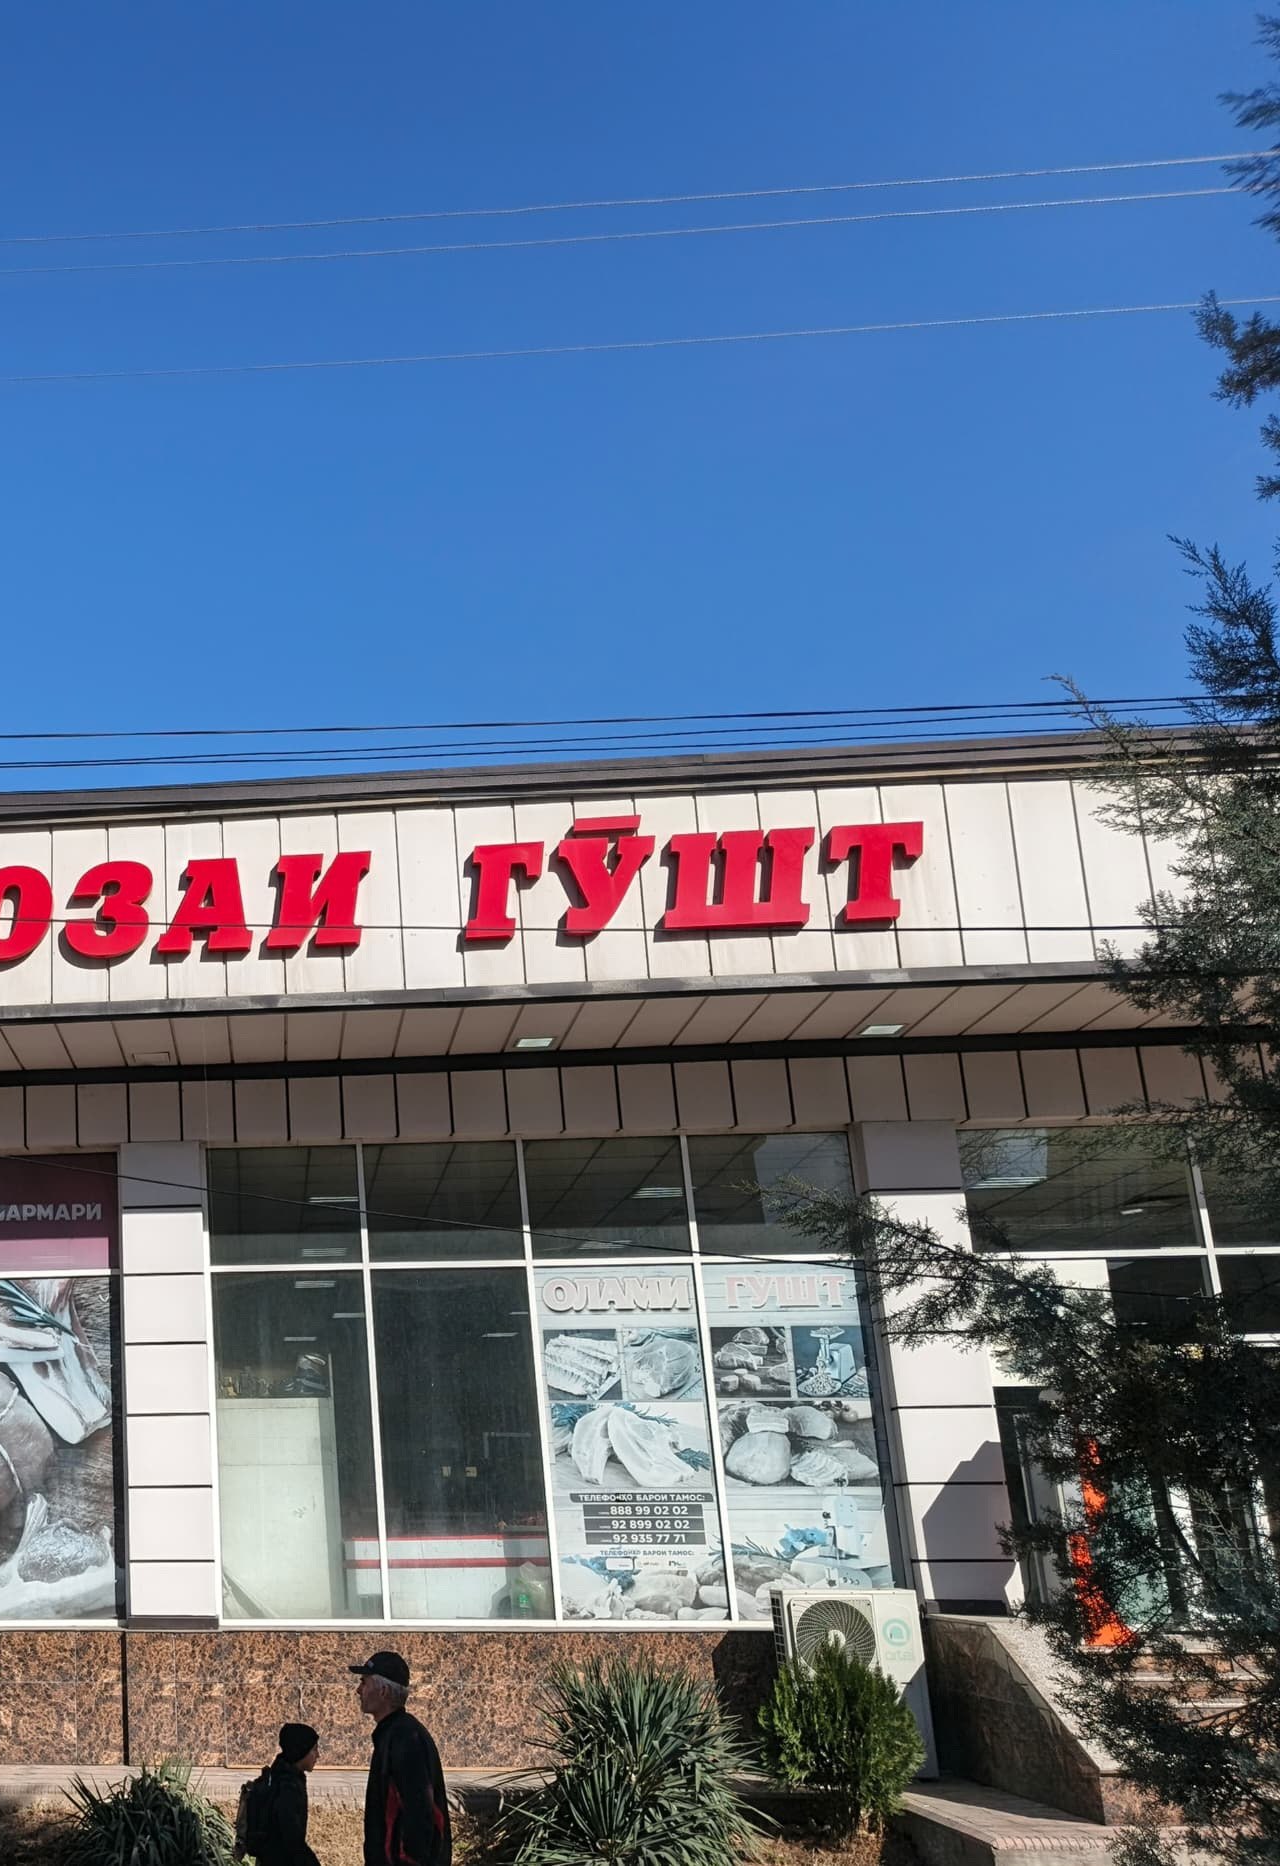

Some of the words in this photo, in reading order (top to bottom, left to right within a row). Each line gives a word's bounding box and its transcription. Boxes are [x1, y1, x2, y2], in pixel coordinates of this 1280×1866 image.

[542, 1276, 692, 1312] ОЛАМИ
[610, 1506, 633, 1515] 888
[635, 1506, 651, 1515] 99
[654, 1505, 670, 1515] 02
[672, 1505, 689, 1515] 02
[611, 1520, 627, 1529] 92
[629, 1520, 652, 1529] 899
[655, 1520, 671, 1529] 02
[674, 1520, 690, 1529] 02
[612, 1534, 628, 1543] 92
[631, 1534, 653, 1543] 935
[656, 1534, 670, 1543] 77
[673, 1534, 687, 1543] 71
